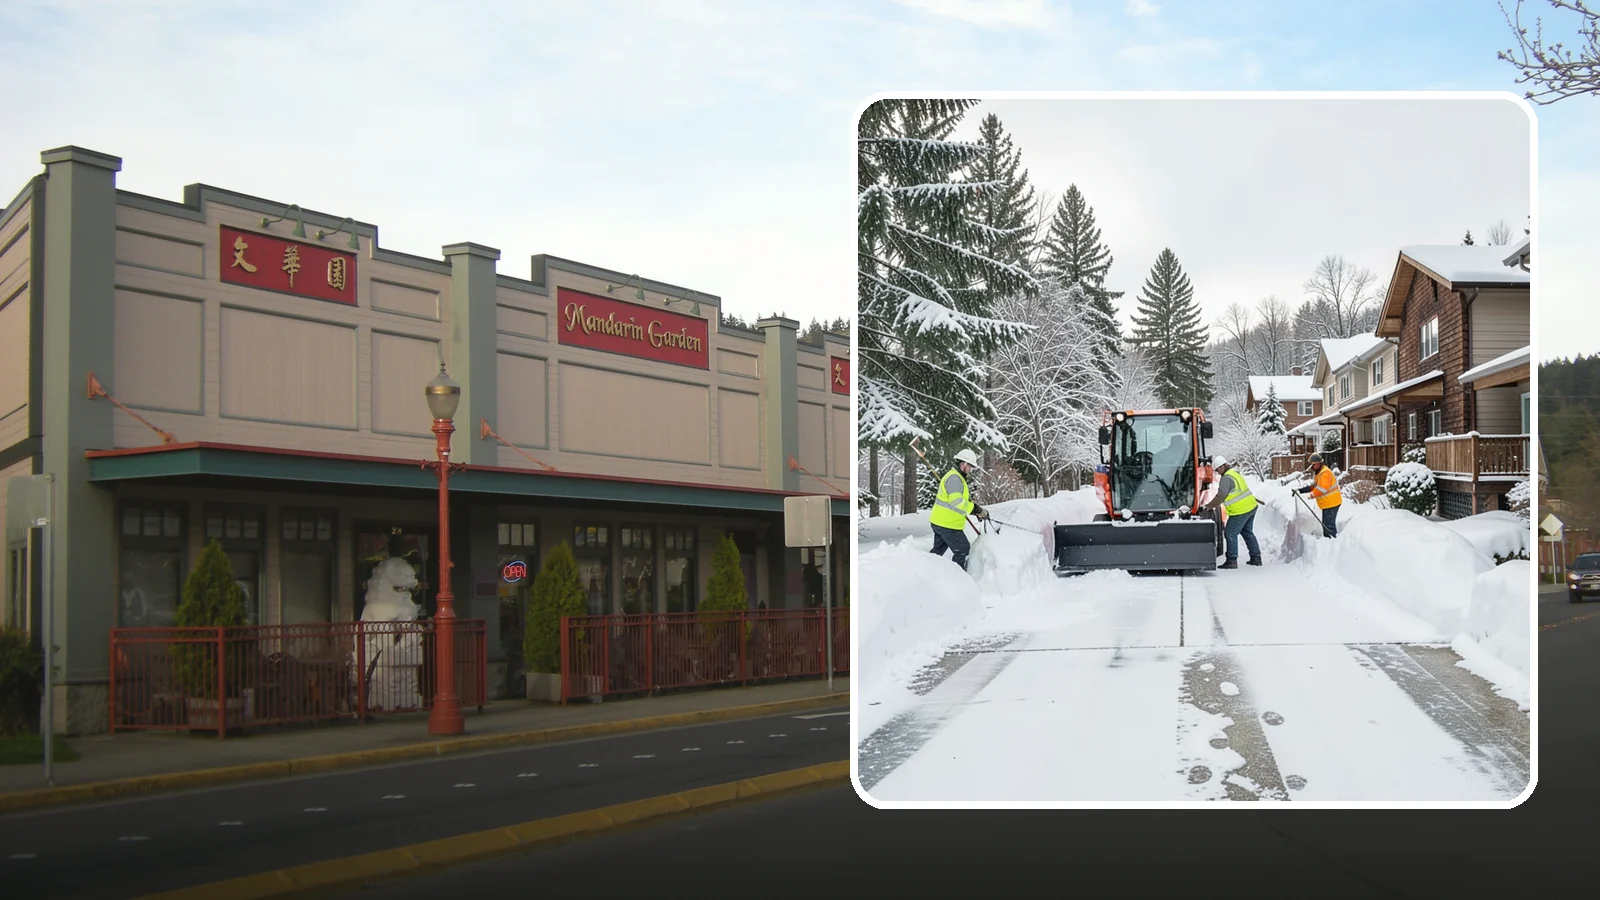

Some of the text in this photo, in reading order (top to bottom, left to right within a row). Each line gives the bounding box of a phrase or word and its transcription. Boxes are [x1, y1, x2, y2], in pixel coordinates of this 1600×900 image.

[230, 235, 347, 291] 文華園
[564, 302, 702, 352] Mandarin Garden
[503, 565, 527, 578] OPEN
